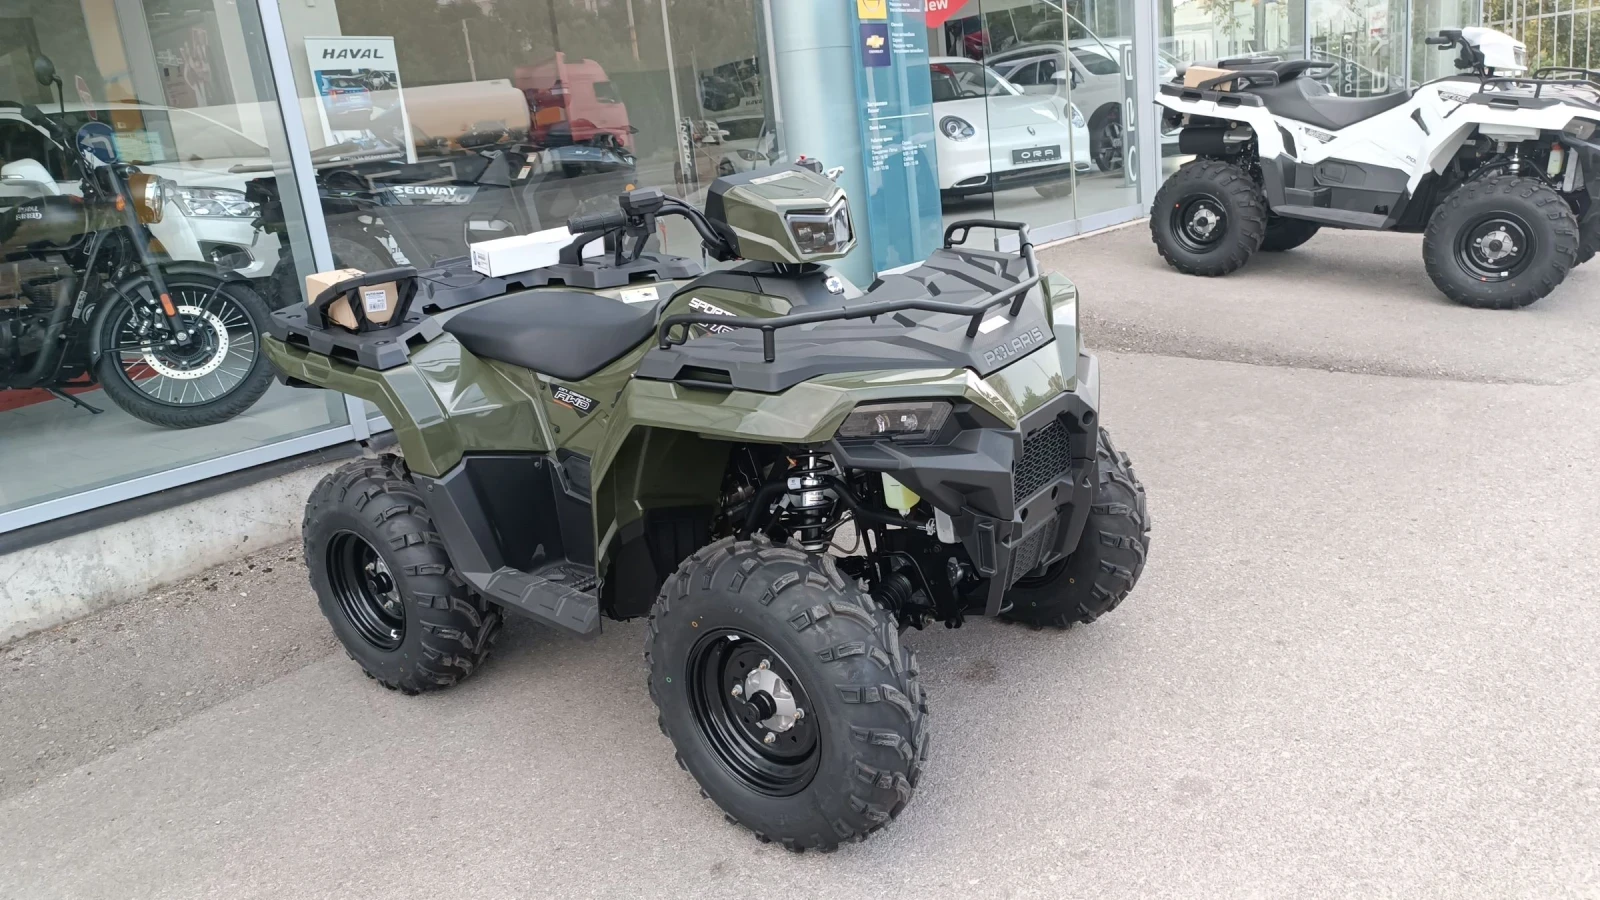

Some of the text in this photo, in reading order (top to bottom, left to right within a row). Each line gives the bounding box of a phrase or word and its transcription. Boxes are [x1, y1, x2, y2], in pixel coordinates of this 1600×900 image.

[322, 48, 384, 59] HAVAL
[1021, 149, 1054, 159] ORA
[393, 185, 457, 196] SEGWAY
[983, 327, 1044, 367] POLARIS
[554, 390, 590, 410] AWD
